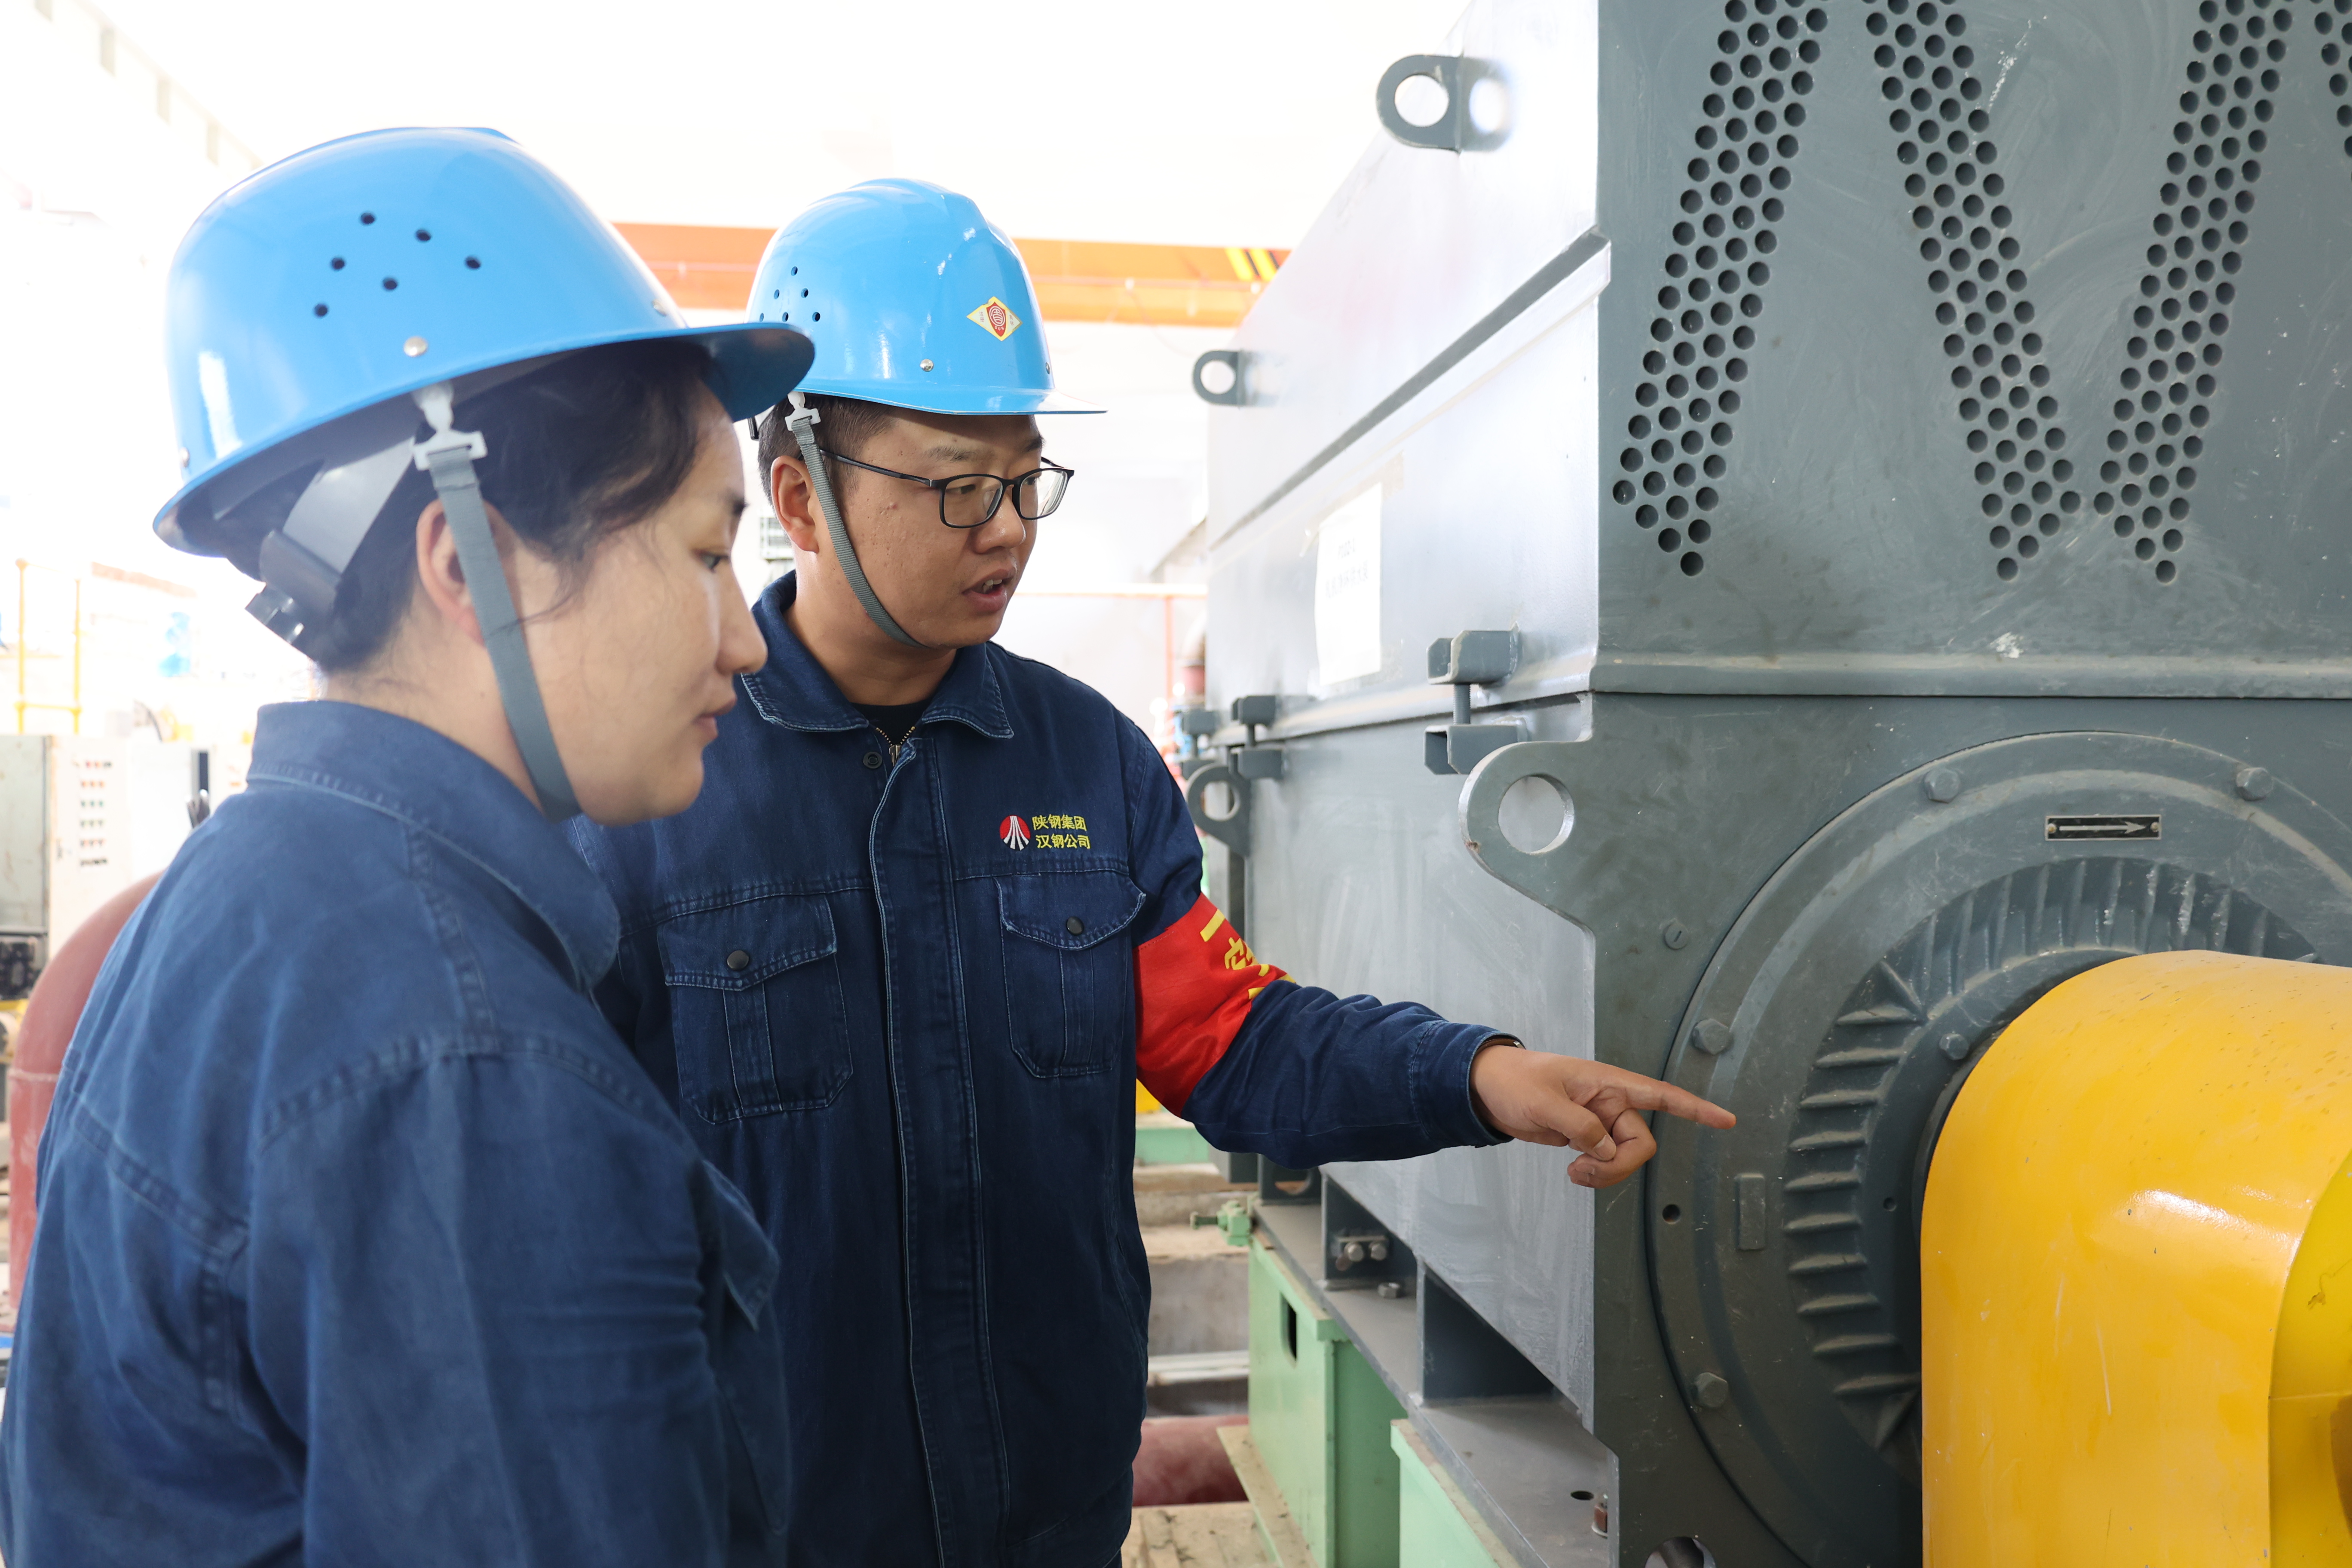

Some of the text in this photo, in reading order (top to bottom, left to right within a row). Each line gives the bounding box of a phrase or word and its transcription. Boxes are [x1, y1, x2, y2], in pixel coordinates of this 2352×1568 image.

[1032, 815, 1087, 831] 陕钢集团
[1035, 833, 1090, 849] 汉钢公司
